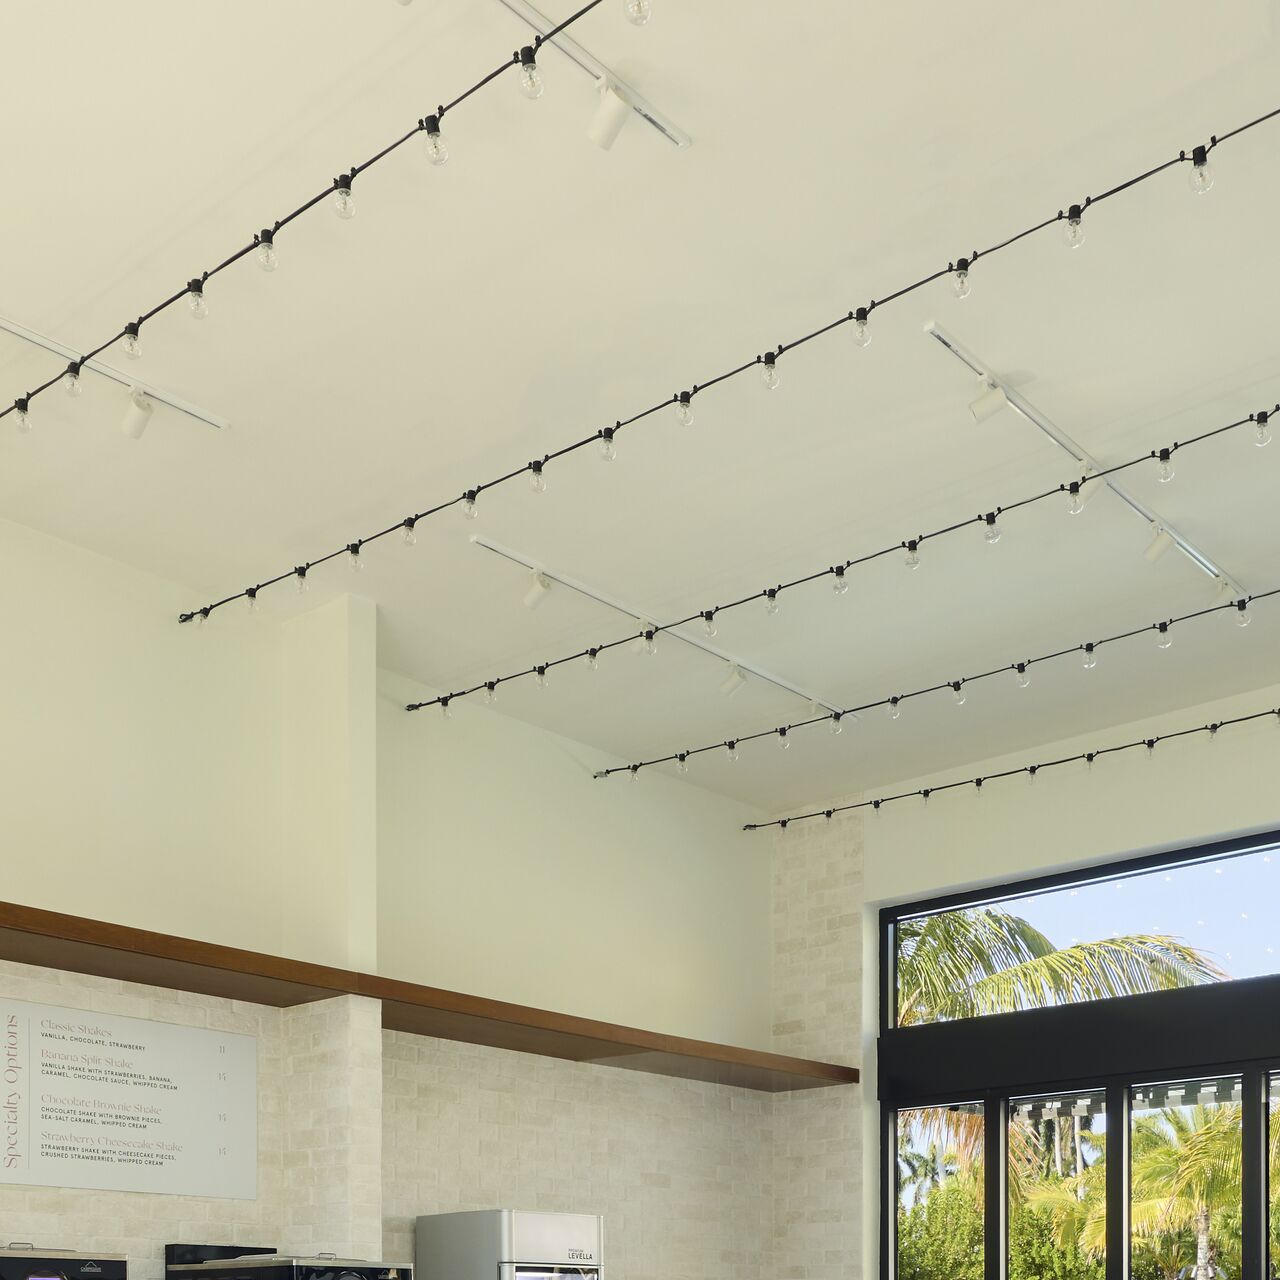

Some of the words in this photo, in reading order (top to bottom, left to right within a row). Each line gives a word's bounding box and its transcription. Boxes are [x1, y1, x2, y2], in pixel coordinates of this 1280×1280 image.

[4, 1014, 23, 1084] Options
[40, 1019, 75, 1032] Classic
[78, 1024, 112, 1037] Shakes
[3, 1092, 22, 1169] Specialty
[568, 1252, 593, 1260] LEVELLA
